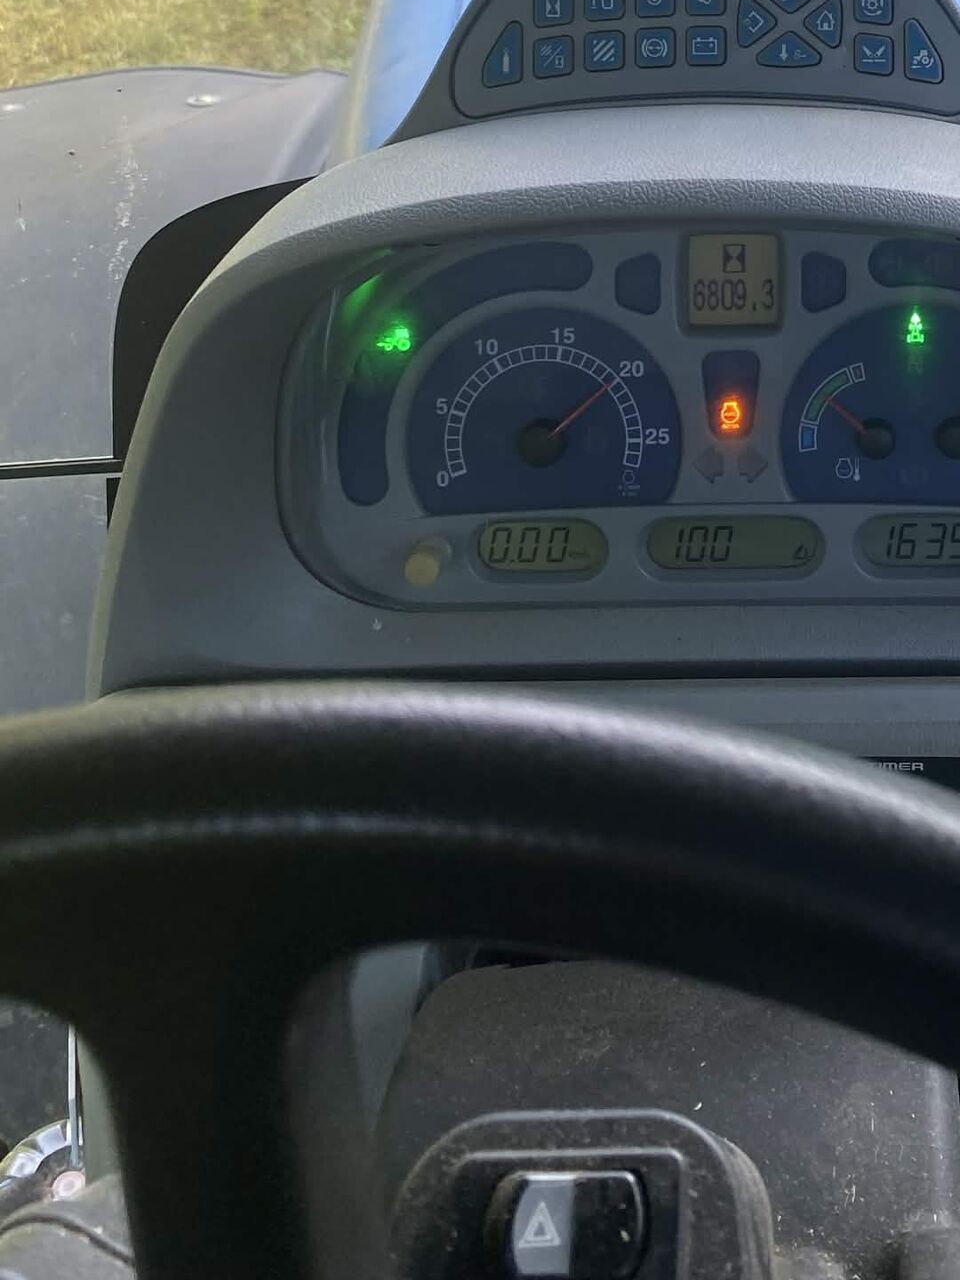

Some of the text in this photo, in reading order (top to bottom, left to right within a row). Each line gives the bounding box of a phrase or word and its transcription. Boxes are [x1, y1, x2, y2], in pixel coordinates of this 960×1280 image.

[694, 278, 774, 311] 6809.3
[551, 328, 576, 344] 15
[474, 339, 499, 356] 10
[619, 361, 645, 378] 20
[436, 399, 448, 415] 5
[645, 428, 670, 445] 25
[436, 472, 449, 488] 0
[675, 526, 733, 562] 100
